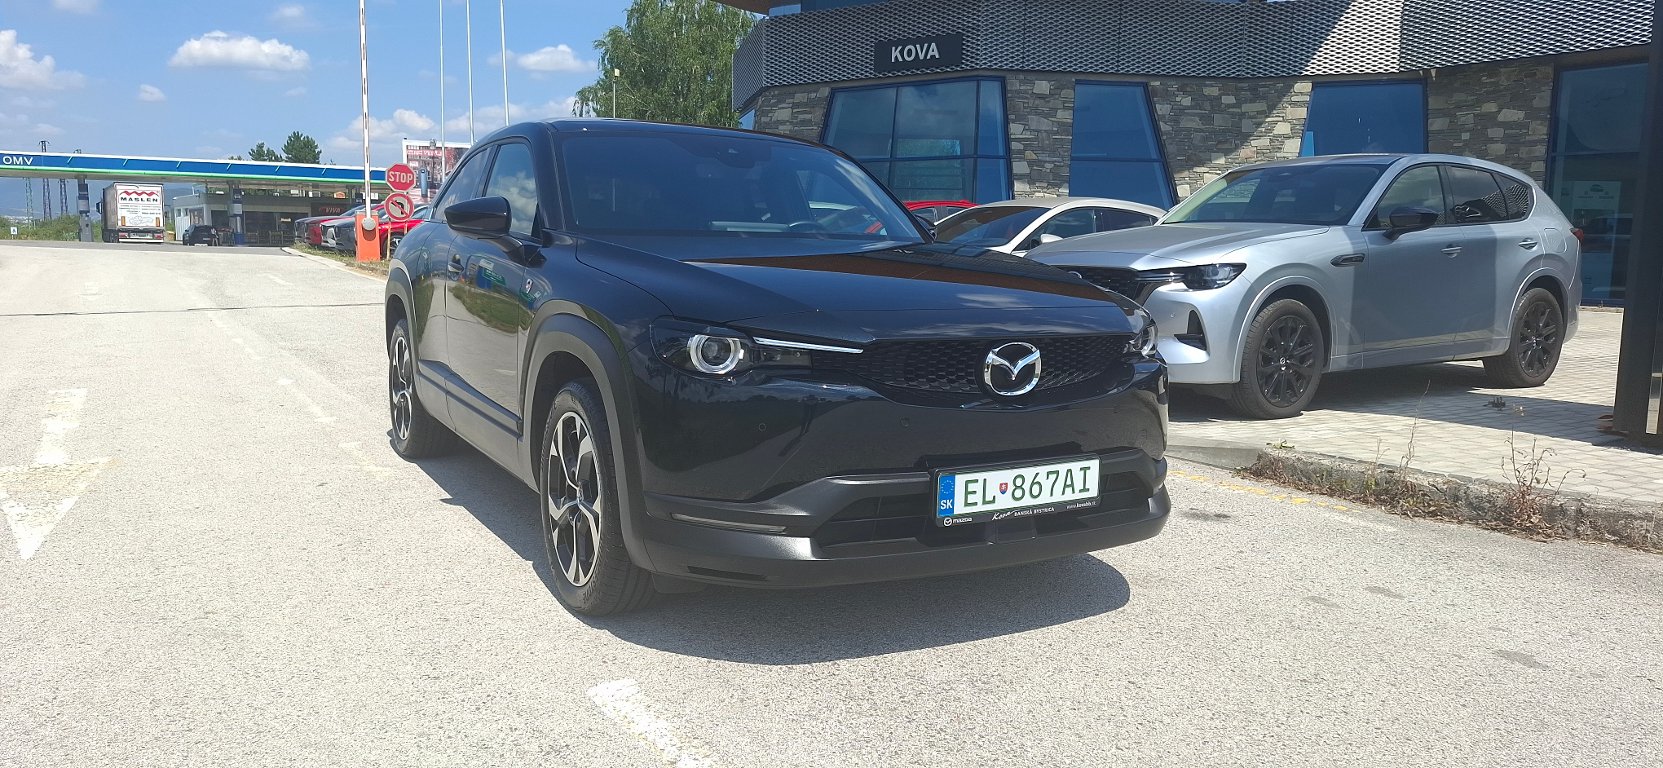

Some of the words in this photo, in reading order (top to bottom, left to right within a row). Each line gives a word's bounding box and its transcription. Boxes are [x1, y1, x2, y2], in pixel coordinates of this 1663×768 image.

[891, 42, 940, 63] KOVA
[2, 156, 34, 165] OMV
[388, 171, 413, 183] STOP
[963, 478, 996, 508] EL
[1011, 466, 1091, 502] 867AI
[940, 499, 953, 510] SK
